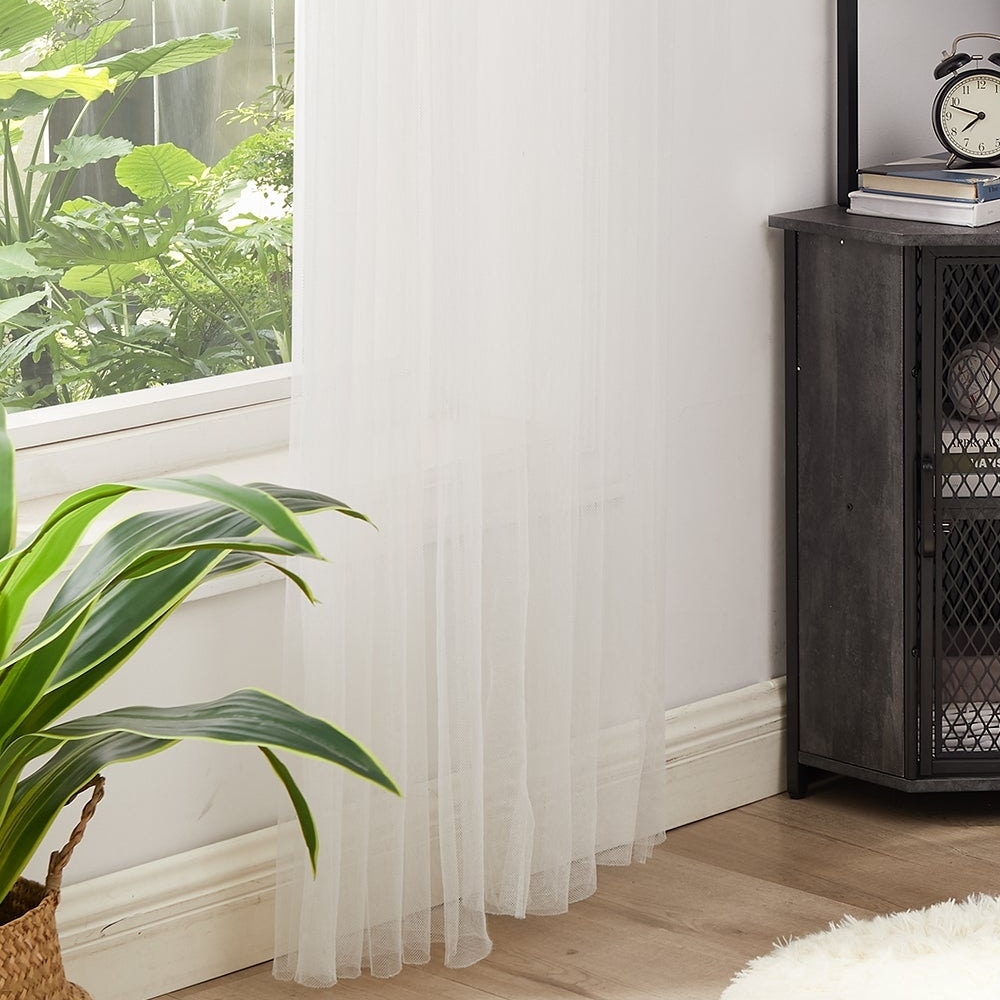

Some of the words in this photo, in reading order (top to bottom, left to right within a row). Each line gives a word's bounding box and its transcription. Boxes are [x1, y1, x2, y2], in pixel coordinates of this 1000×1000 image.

[977, 80, 986, 89] 12
[994, 85, 999, 93] 1
[962, 86, 970, 94] 11
[951, 97, 960, 106] 10
[945, 112, 952, 120] 9
[951, 127, 958, 136] 8
[963, 138, 969, 147] 7
[979, 143, 985, 151] 6
[995, 138, 1000, 147] 5
